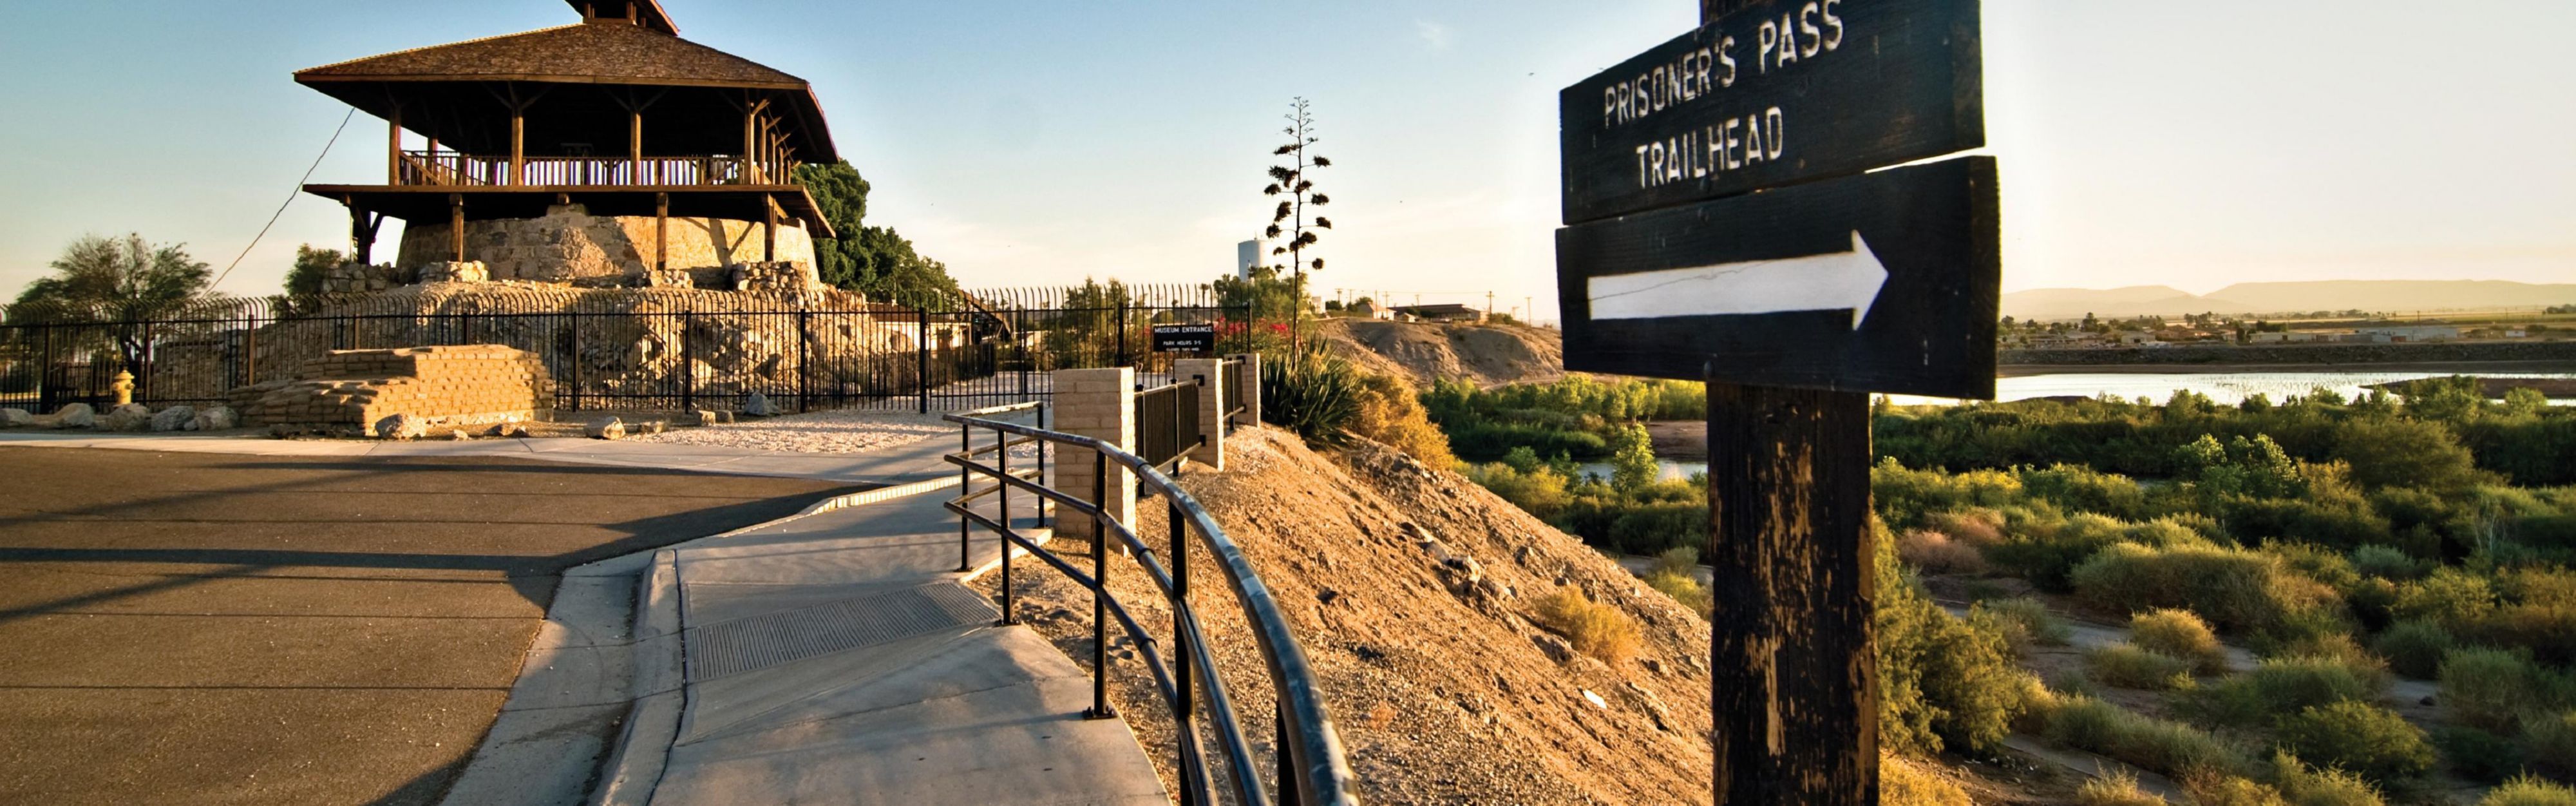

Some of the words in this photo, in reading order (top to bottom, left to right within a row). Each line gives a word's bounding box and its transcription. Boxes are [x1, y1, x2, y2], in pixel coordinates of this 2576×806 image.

[1604, 35, 1736, 129] PRISONER'S
[1757, 0, 1844, 74] PASS
[1635, 106, 1783, 189] TRAILHEAD
